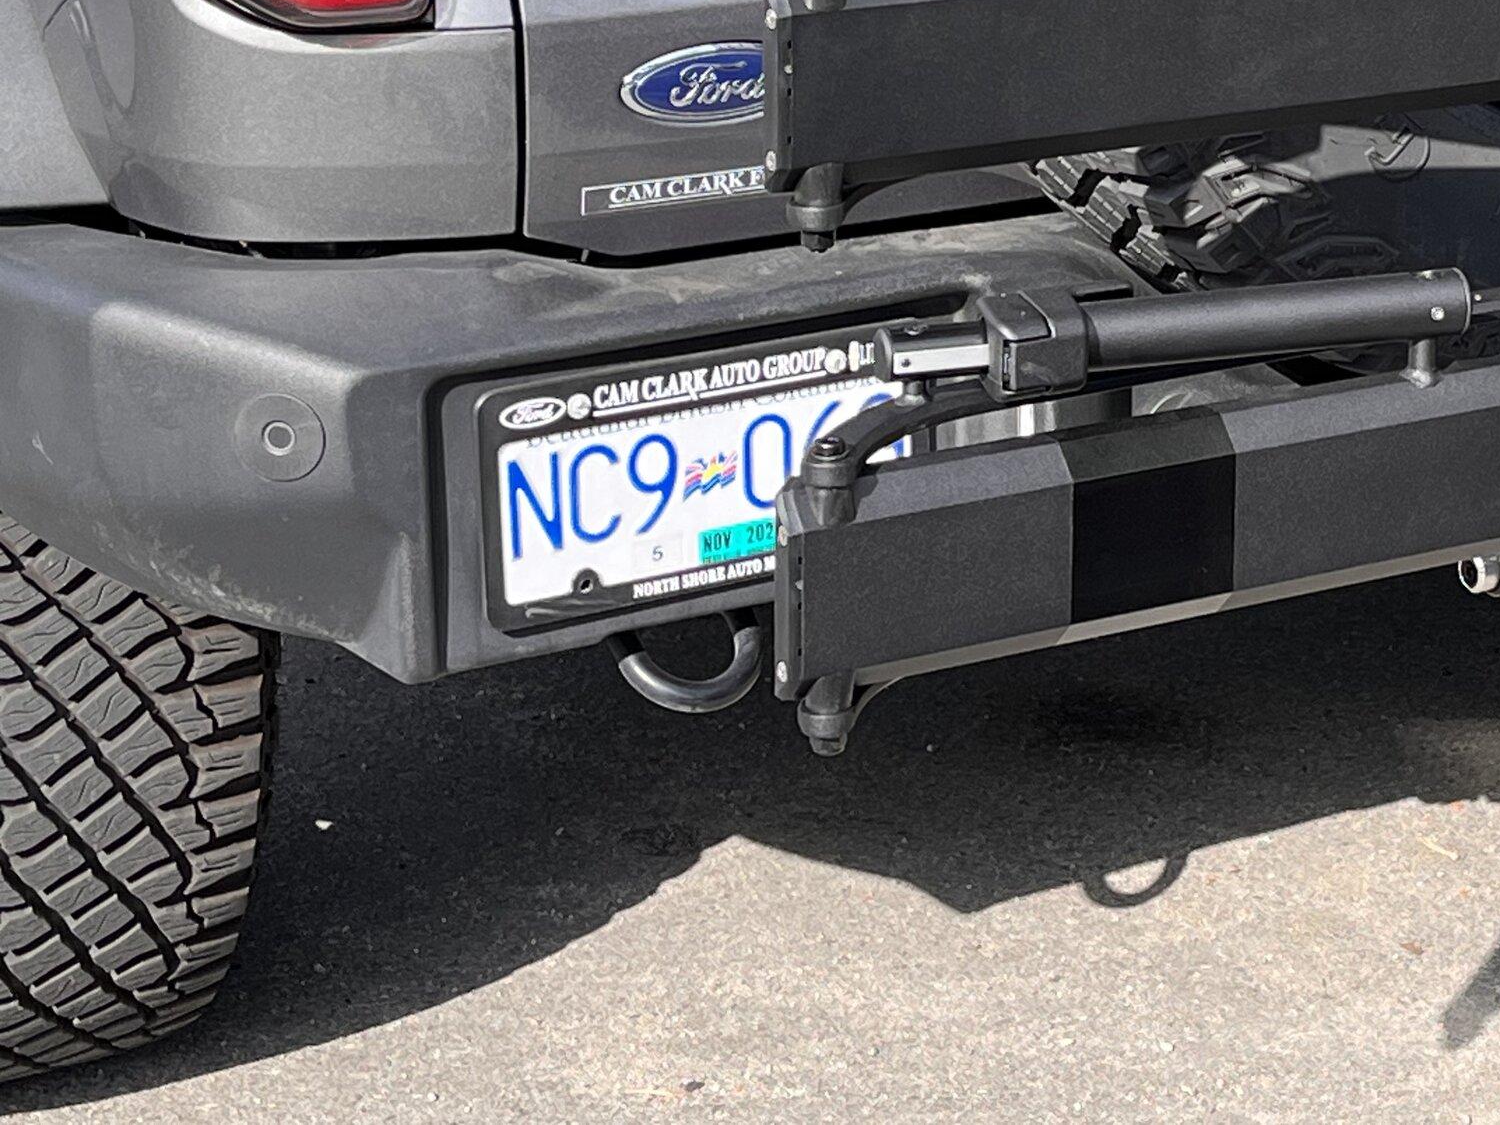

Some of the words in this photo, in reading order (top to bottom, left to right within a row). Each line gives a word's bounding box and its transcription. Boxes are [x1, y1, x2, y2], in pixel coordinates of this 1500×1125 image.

[669, 61, 766, 108] Ford
[609, 181, 662, 206] CAM
[667, 169, 746, 196] CLARK
[593, 379, 639, 409] CAM
[641, 368, 708, 401] CLARK
[709, 359, 761, 389] AUTO
[762, 346, 827, 379] GROUP
[506, 432, 679, 561] NC9
[702, 530, 732, 553] NOV
[746, 521, 774, 544] 202
[633, 576, 680, 599] NORTH
[681, 565, 726, 591] SHORE
[727, 558, 763, 579] AUTO
